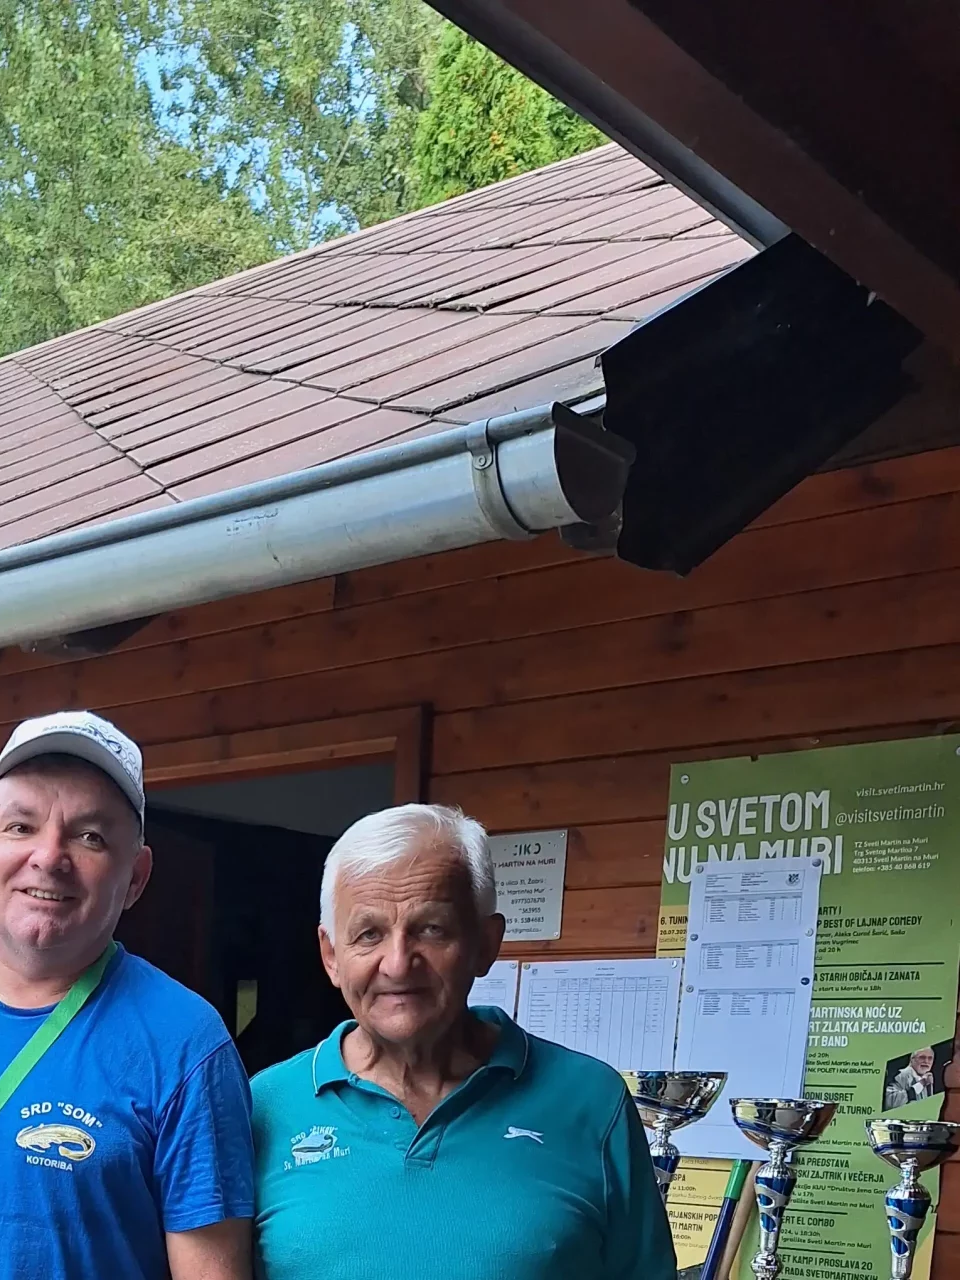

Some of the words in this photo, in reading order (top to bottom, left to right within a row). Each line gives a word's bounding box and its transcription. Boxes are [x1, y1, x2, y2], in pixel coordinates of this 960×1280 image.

[856, 782, 945, 797] visit.svetimartin.hr
[668, 803, 690, 840] U
[695, 790, 830, 838] SVETOM
[835, 804, 944, 826] @visitsvetimartin
[864, 840, 879, 848] Sveti
[865, 848, 886, 856] Svetog
[874, 856, 889, 864] Sveti
[660, 916, 667, 925] 6.
[824, 919, 844, 928] BEST
[845, 918, 855, 928] OF
[857, 917, 888, 927] LAJNAP
[889, 916, 922, 926] COMEDY
[820, 972, 847, 981] STARIH
[849, 970, 883, 981] OBIČAJA
[884, 972, 887, 980] I
[889, 971, 920, 981] ZANATA
[865, 1003, 886, 1018] NOĆ
[888, 1006, 903, 1018] UZ
[822, 1021, 859, 1032] ZLATKA
[861, 1018, 926, 1033] PEJAKOVIĆA
[821, 1036, 848, 1047] BAND
[824, 1092, 854, 1102] SUSRET
[20, 1102, 52, 1120] SRD
[58, 1102, 103, 1129] "SOM"
[334, 1146, 350, 1158] Muri
[26, 1156, 73, 1172] KOTORIBA
[806, 1158, 850, 1168] PREDSTAVA
[810, 1170, 842, 1180] ZAJTRIK
[848, 1171, 884, 1183] VEČERJA
[678, 1222, 703, 1232] MARTIN
[782, 1216, 795, 1224] ERT
[797, 1217, 805, 1225] EL
[808, 1218, 835, 1228] COMBO
[793, 1255, 813, 1265] KAMP
[815, 1257, 817, 1265] I
[819, 1258, 859, 1269] PROSLAVA
[861, 1262, 872, 1270] 20
[785, 1267, 804, 1276] RADA
